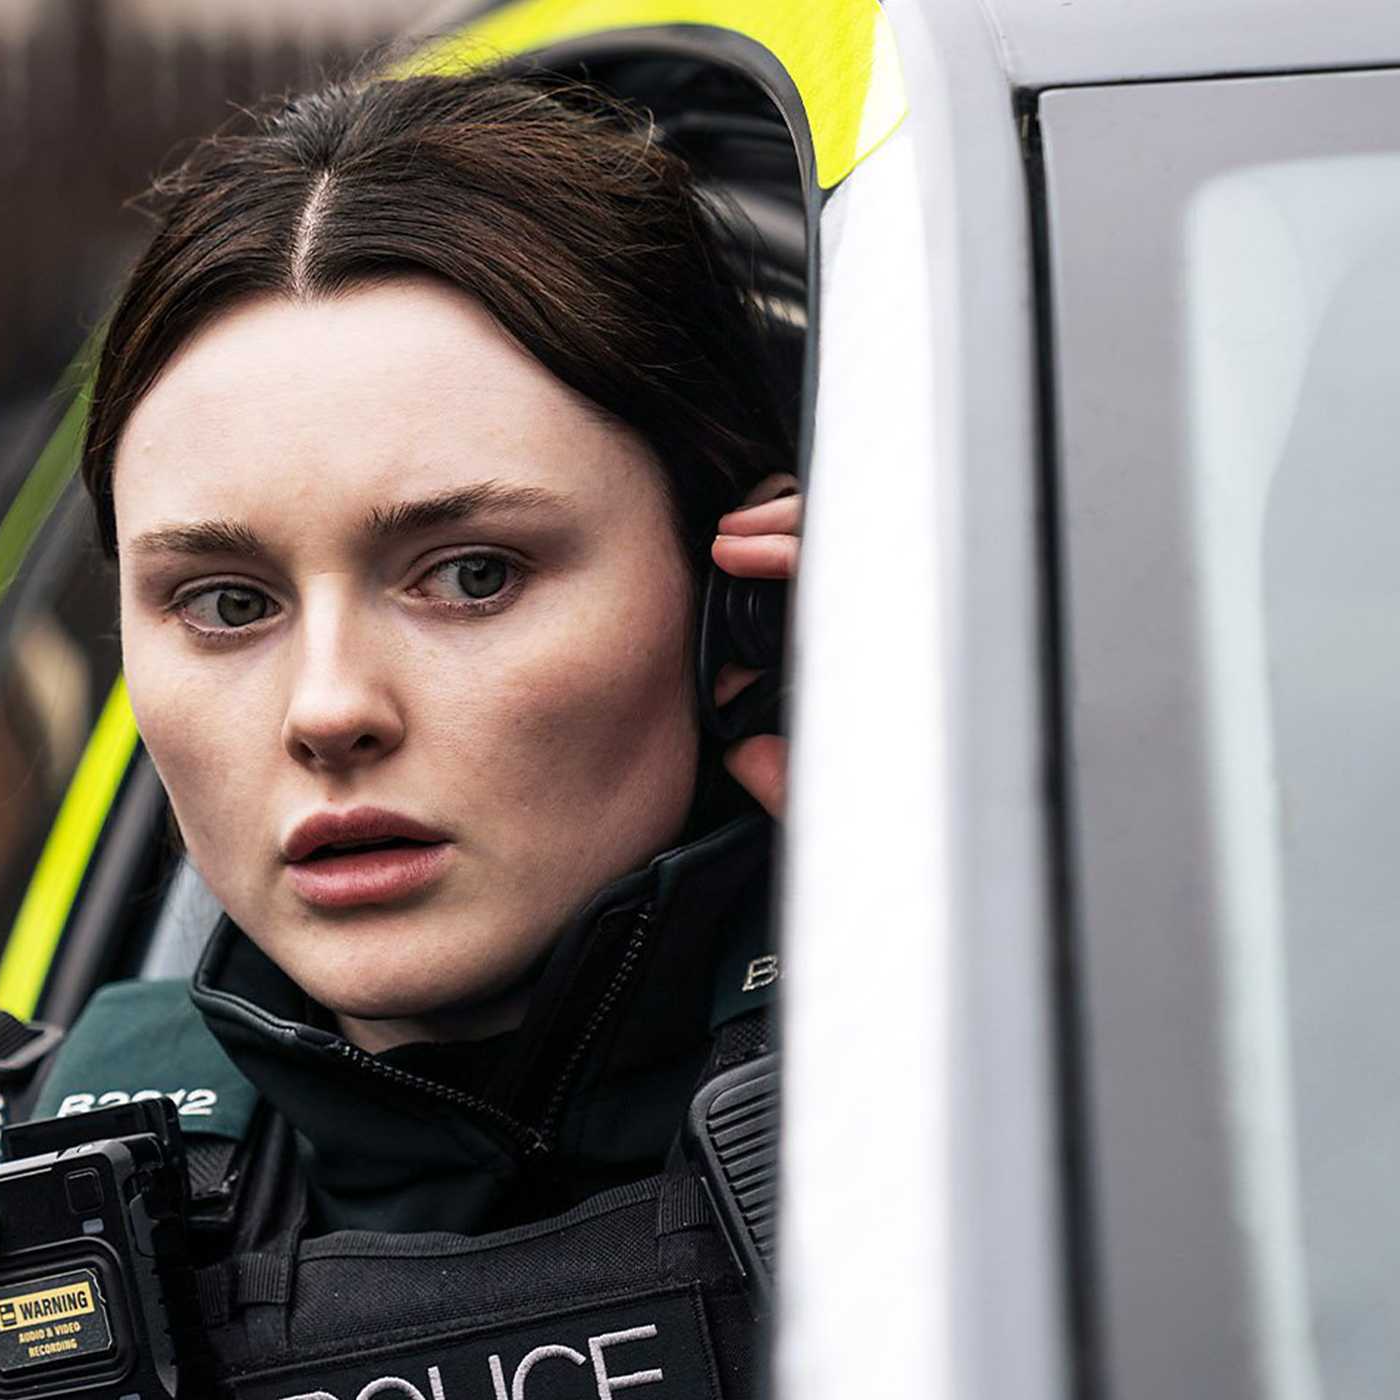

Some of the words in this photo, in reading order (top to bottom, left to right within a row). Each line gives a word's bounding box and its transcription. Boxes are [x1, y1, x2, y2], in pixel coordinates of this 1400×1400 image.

[19, 1291, 88, 1320] WARNING
[18, 1329, 45, 1344] AUDIO
[54, 1321, 82, 1336] VIDEO
[28, 1338, 78, 1357] RECORDING
